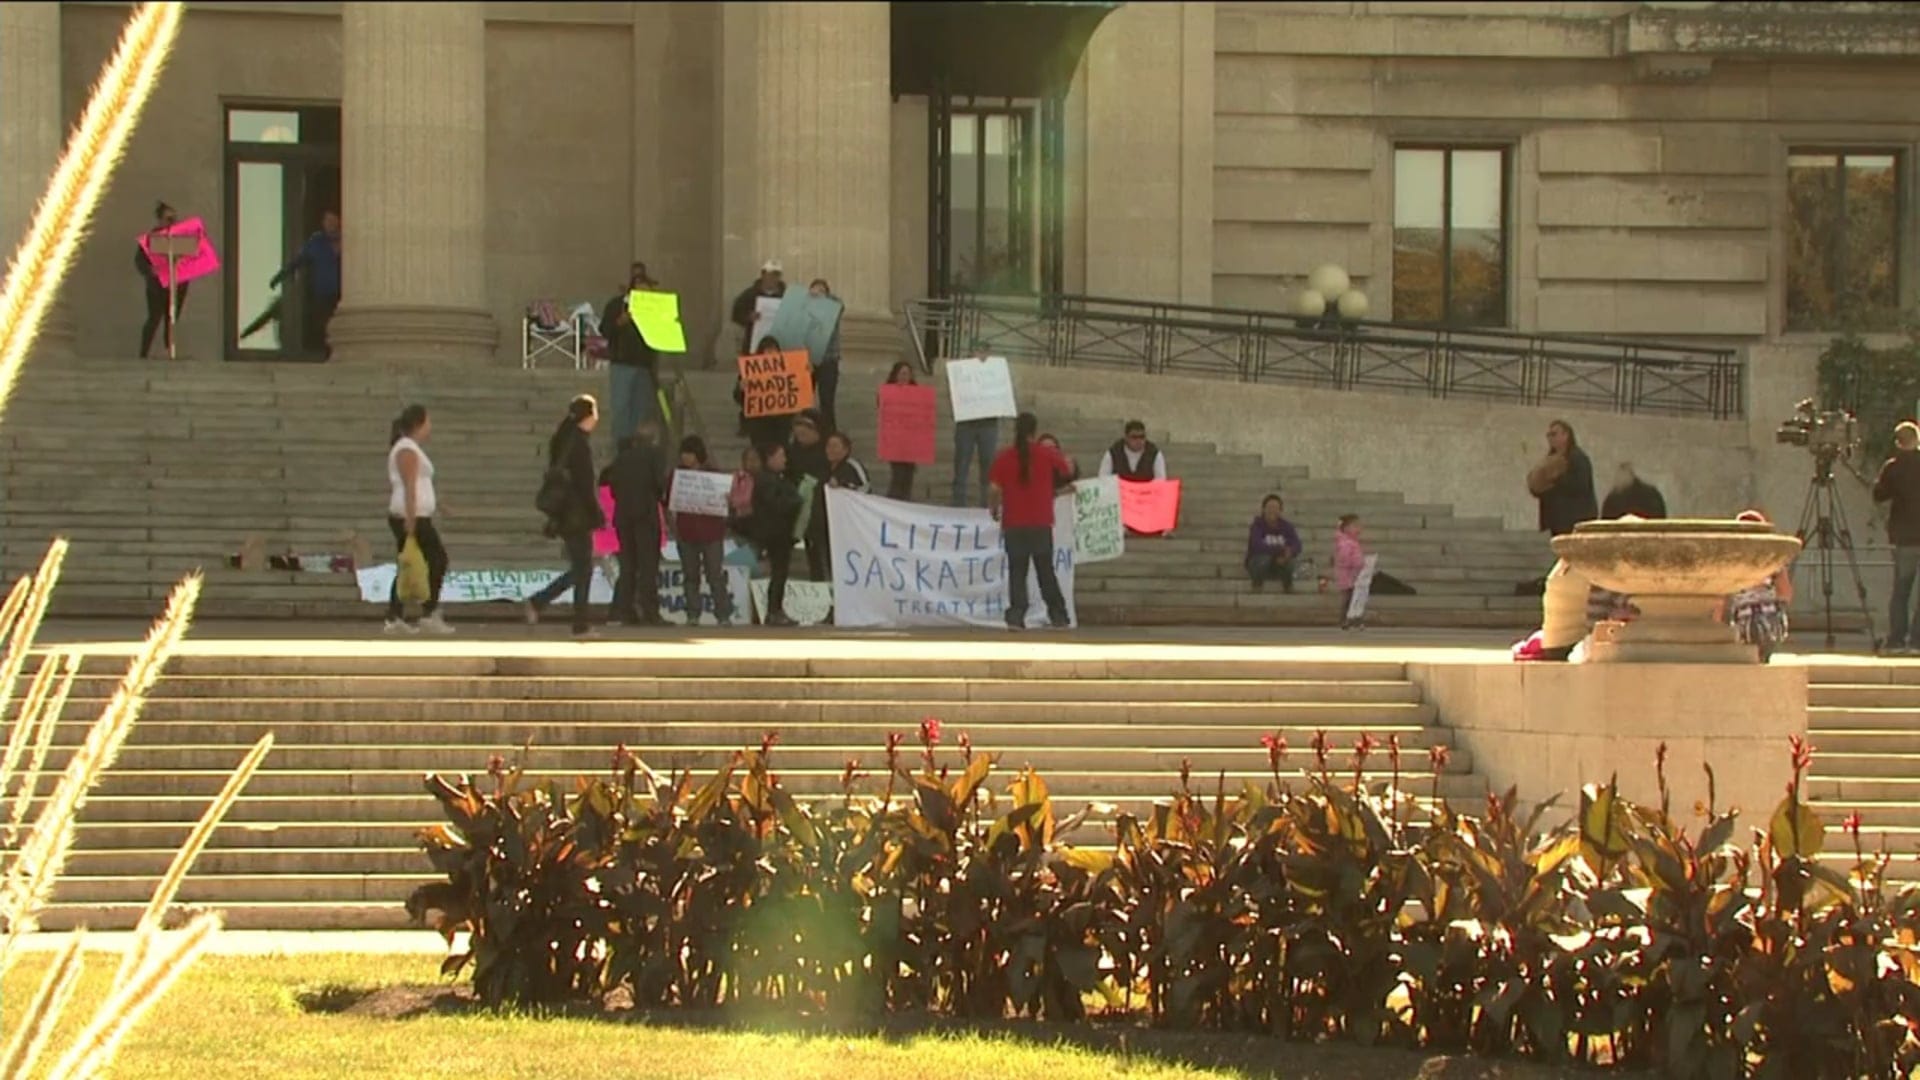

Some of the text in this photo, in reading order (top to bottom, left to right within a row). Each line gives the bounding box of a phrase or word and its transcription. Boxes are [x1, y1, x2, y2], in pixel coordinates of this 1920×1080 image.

[744, 355, 786, 377] MAN
[747, 373, 799, 394] MADE
[894, 598, 974, 616] TREATY
